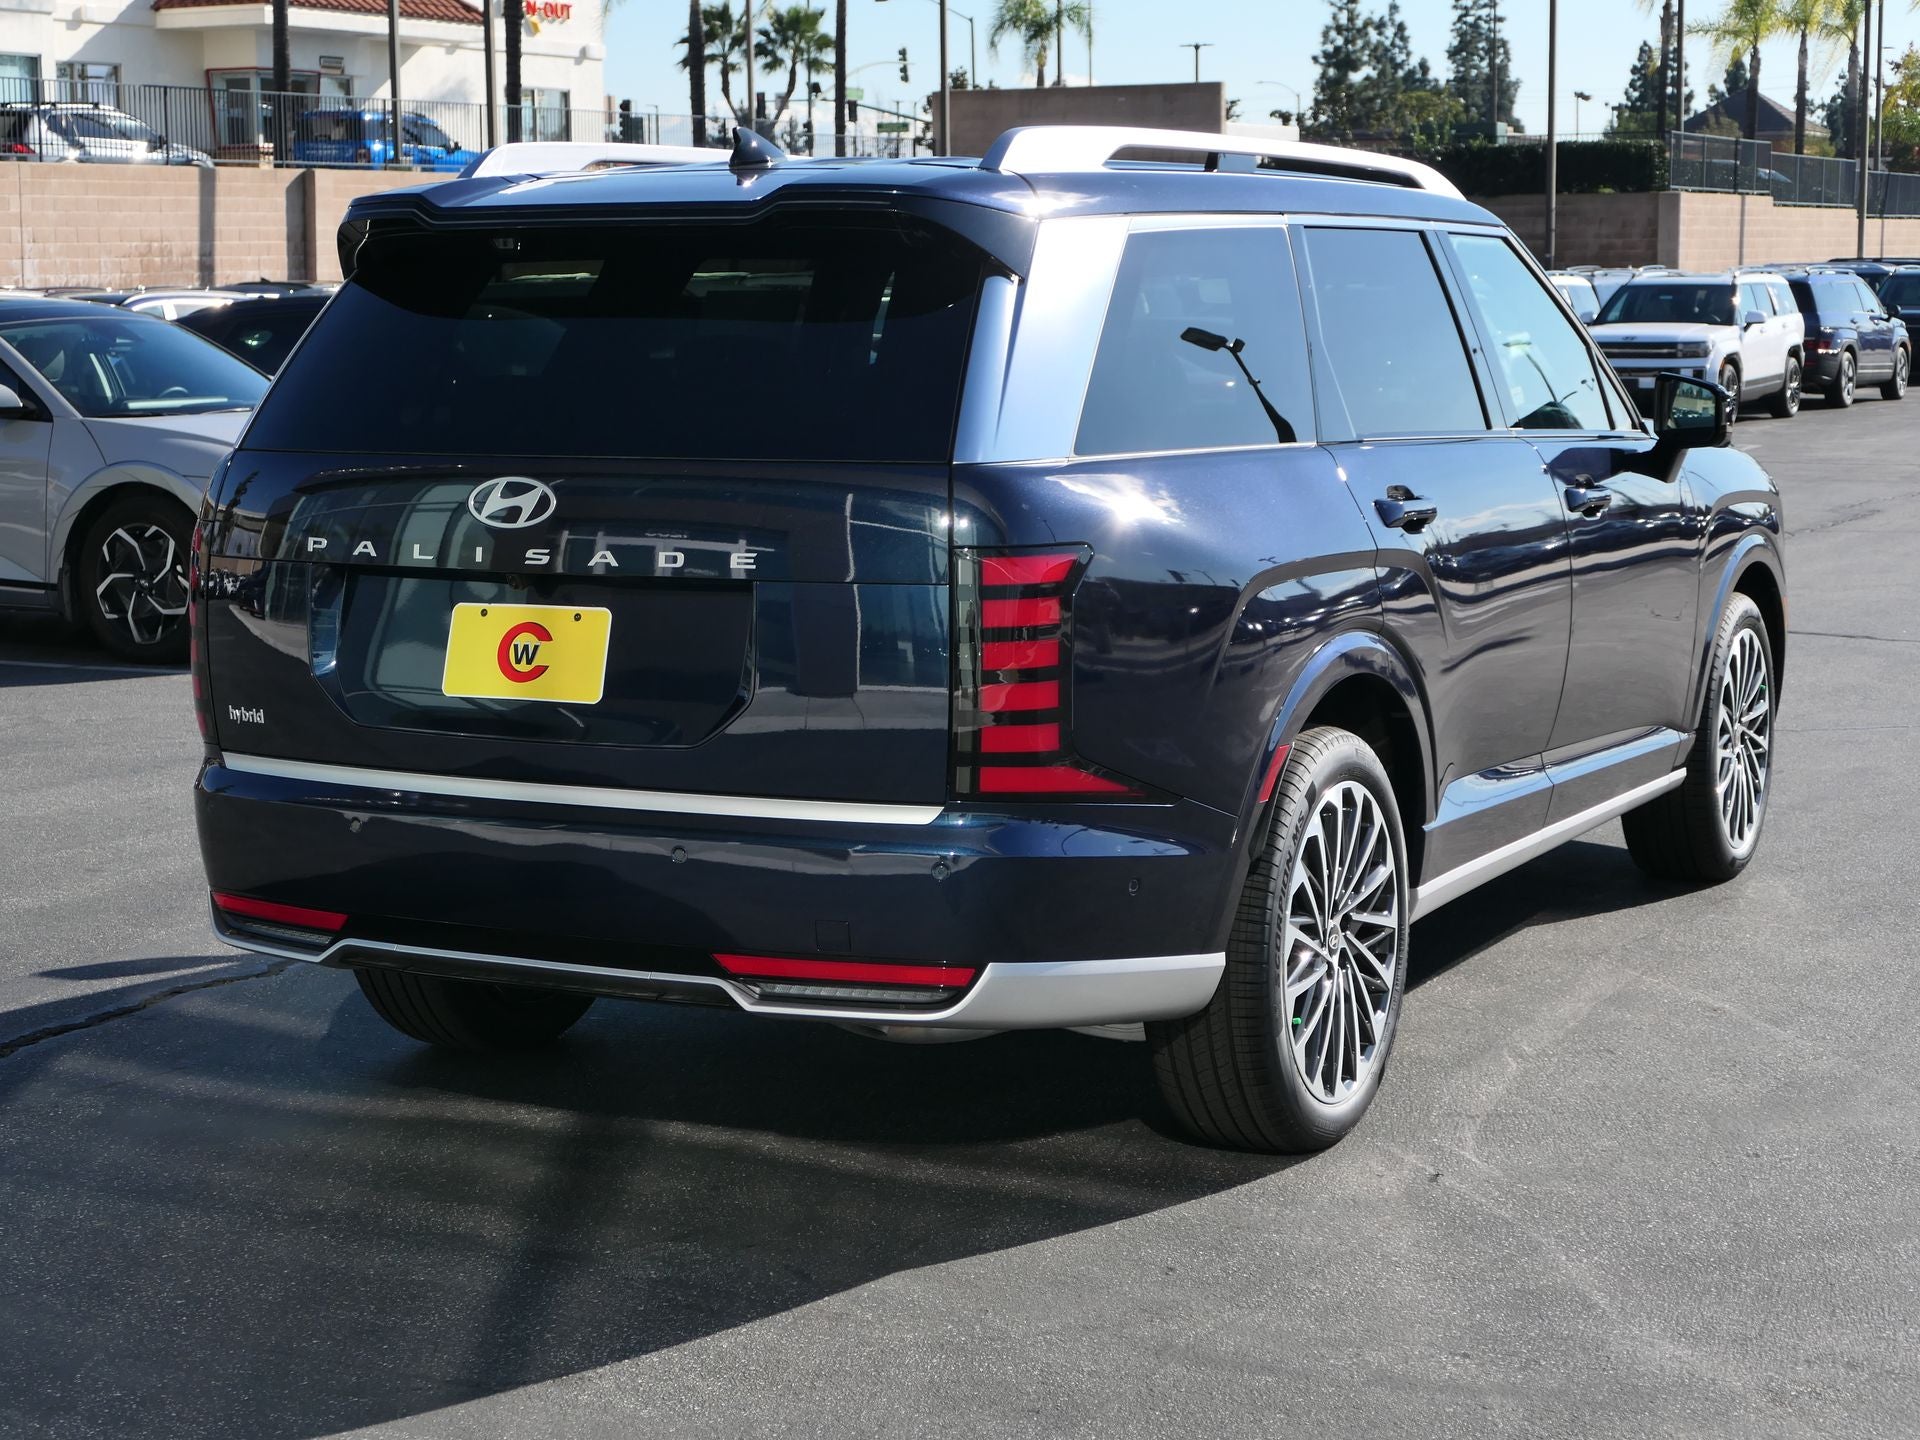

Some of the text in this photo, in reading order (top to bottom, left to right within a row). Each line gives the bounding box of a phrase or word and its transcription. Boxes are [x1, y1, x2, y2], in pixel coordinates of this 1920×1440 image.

[525, 0, 572, 19] N-OUT
[307, 536, 758, 570] PALISADE
[228, 704, 265, 725] hybrid
